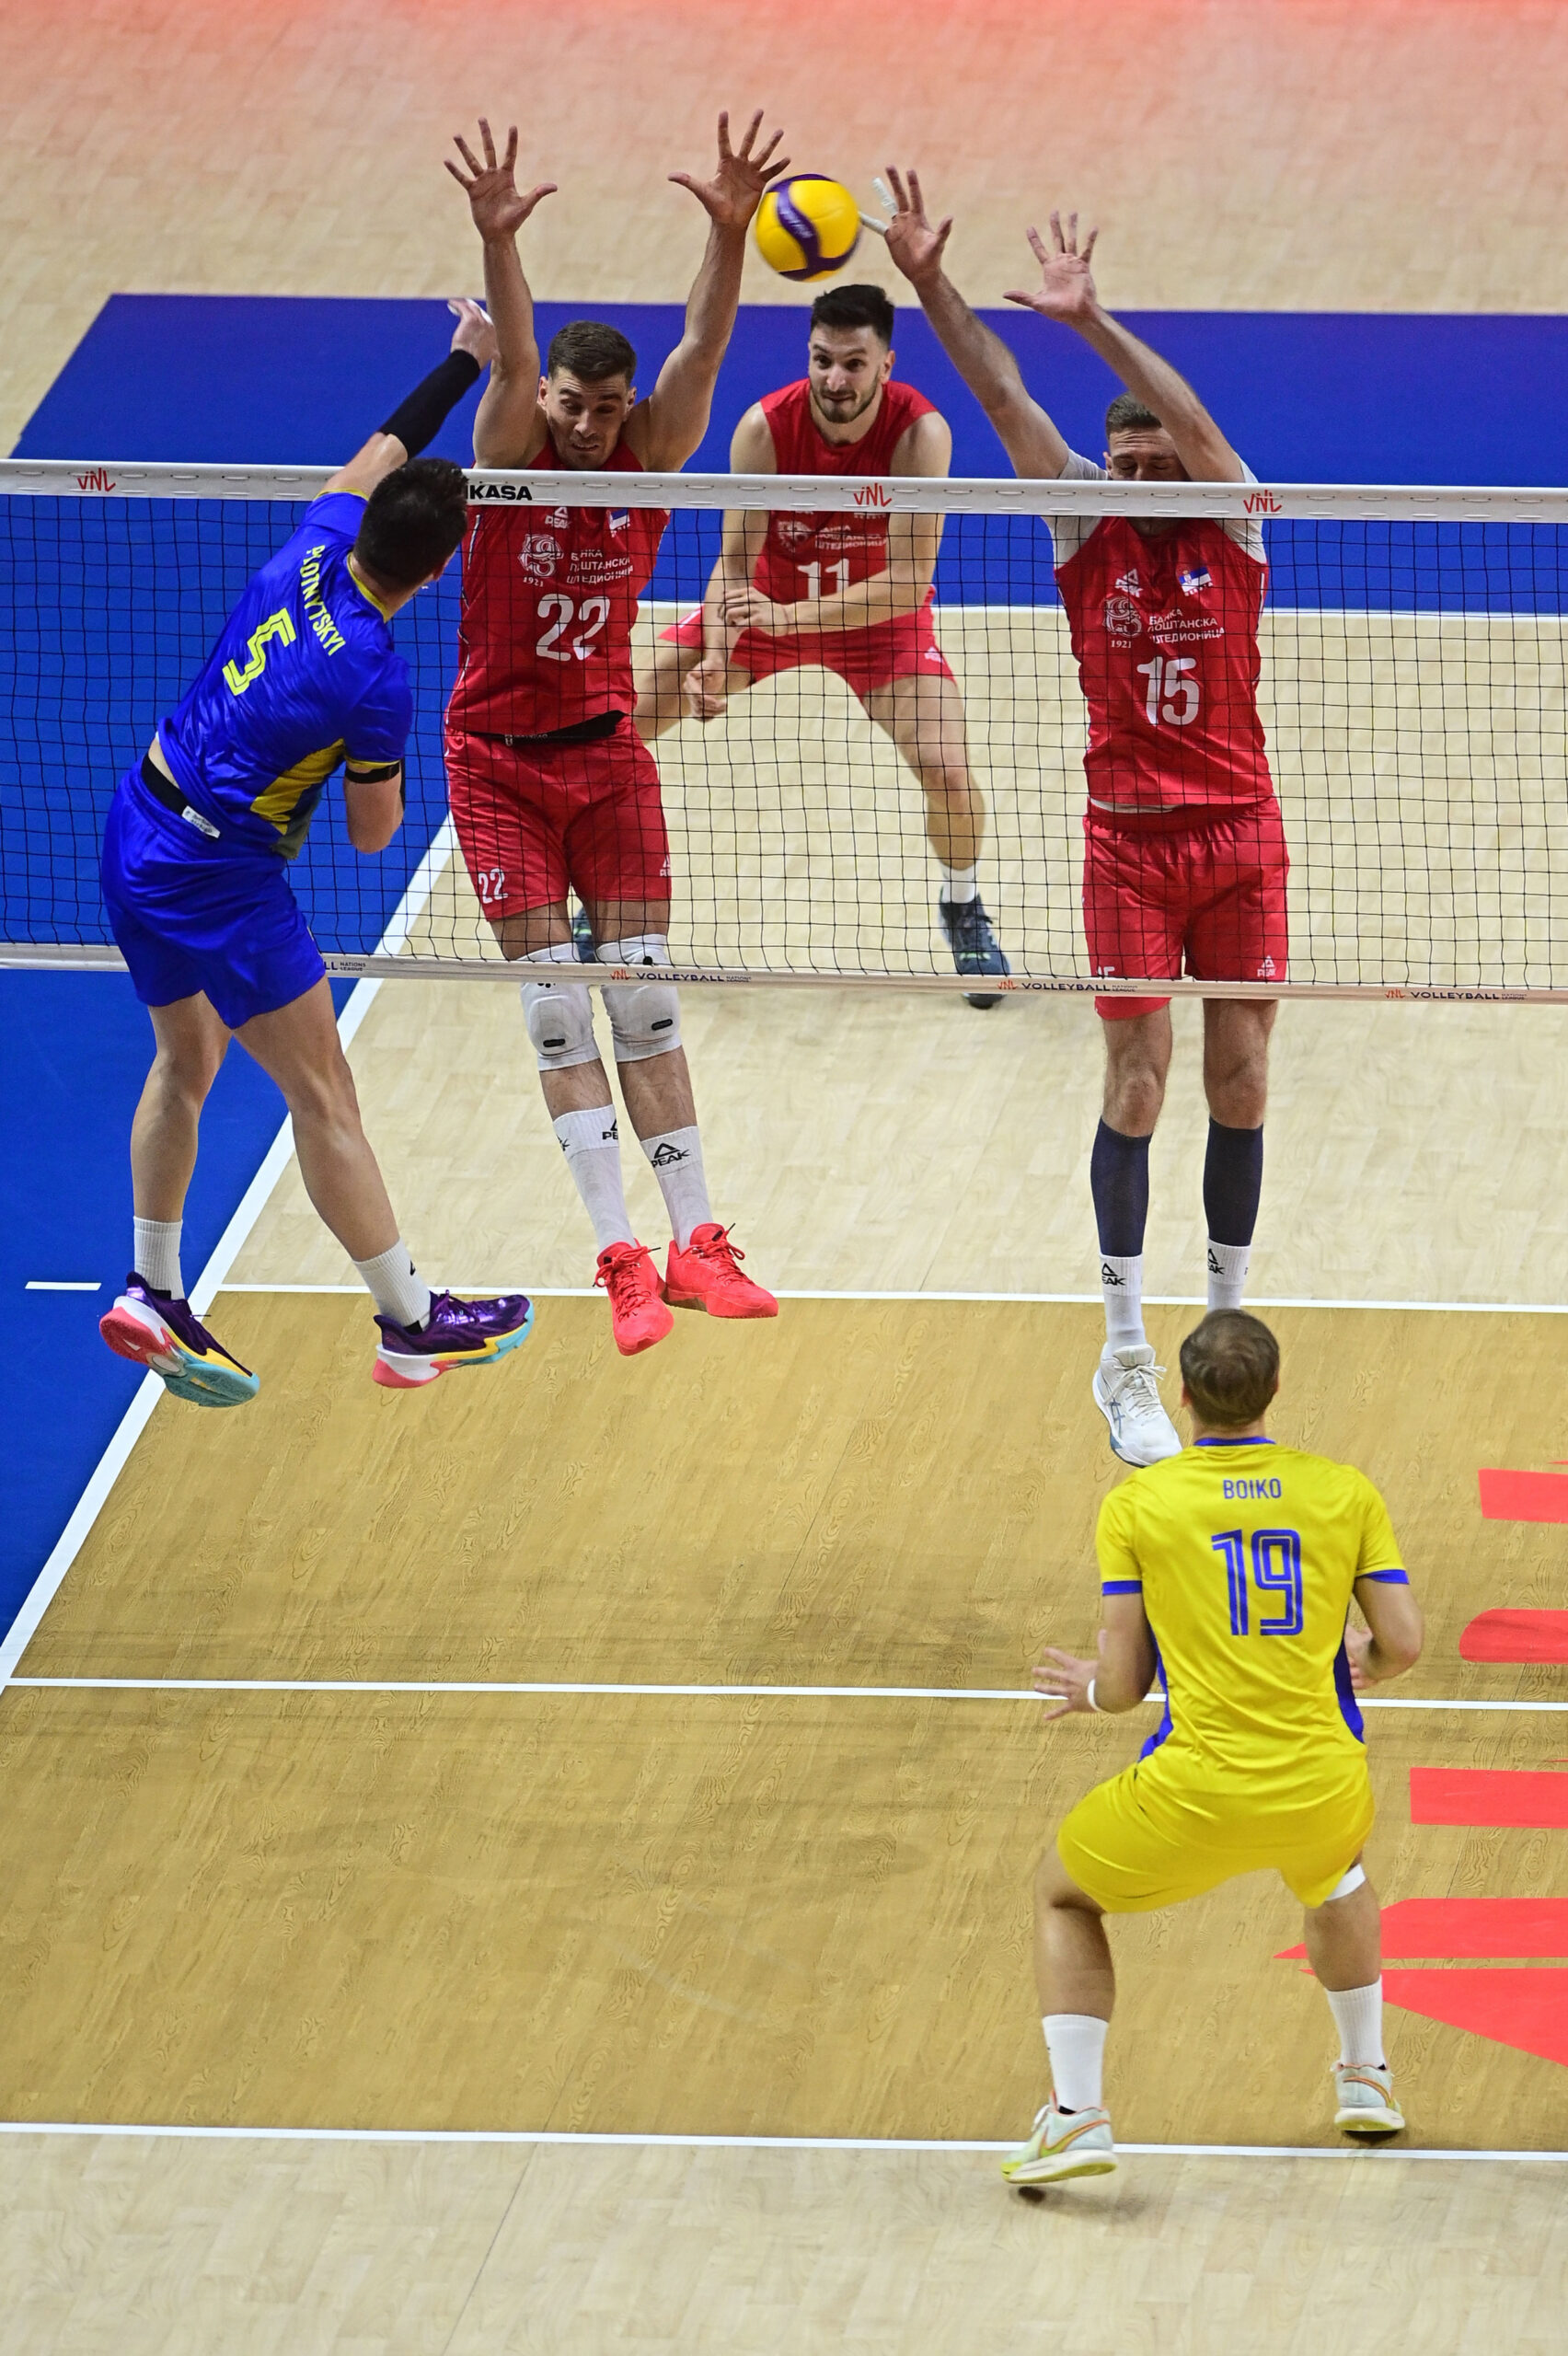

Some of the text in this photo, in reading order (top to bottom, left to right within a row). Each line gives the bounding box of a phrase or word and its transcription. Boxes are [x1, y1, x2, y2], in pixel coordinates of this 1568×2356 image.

[467, 484, 533, 501] KASA
[797, 558, 849, 598] 11
[536, 594, 610, 662] 22
[222, 607, 296, 696] 5
[1111, 640, 1132, 648] 1921
[1136, 655, 1200, 726] 15
[478, 868, 508, 904] 22
[637, 972, 725, 982] VOLLEYBALL
[1021, 982, 1111, 992] VOLLEYBALL
[1411, 991, 1500, 1000] VOLLEYBALL
[650, 1149, 691, 1168] PEAK
[1223, 1478, 1283, 1499] BOIKO
[1211, 1529, 1304, 1636] 19
